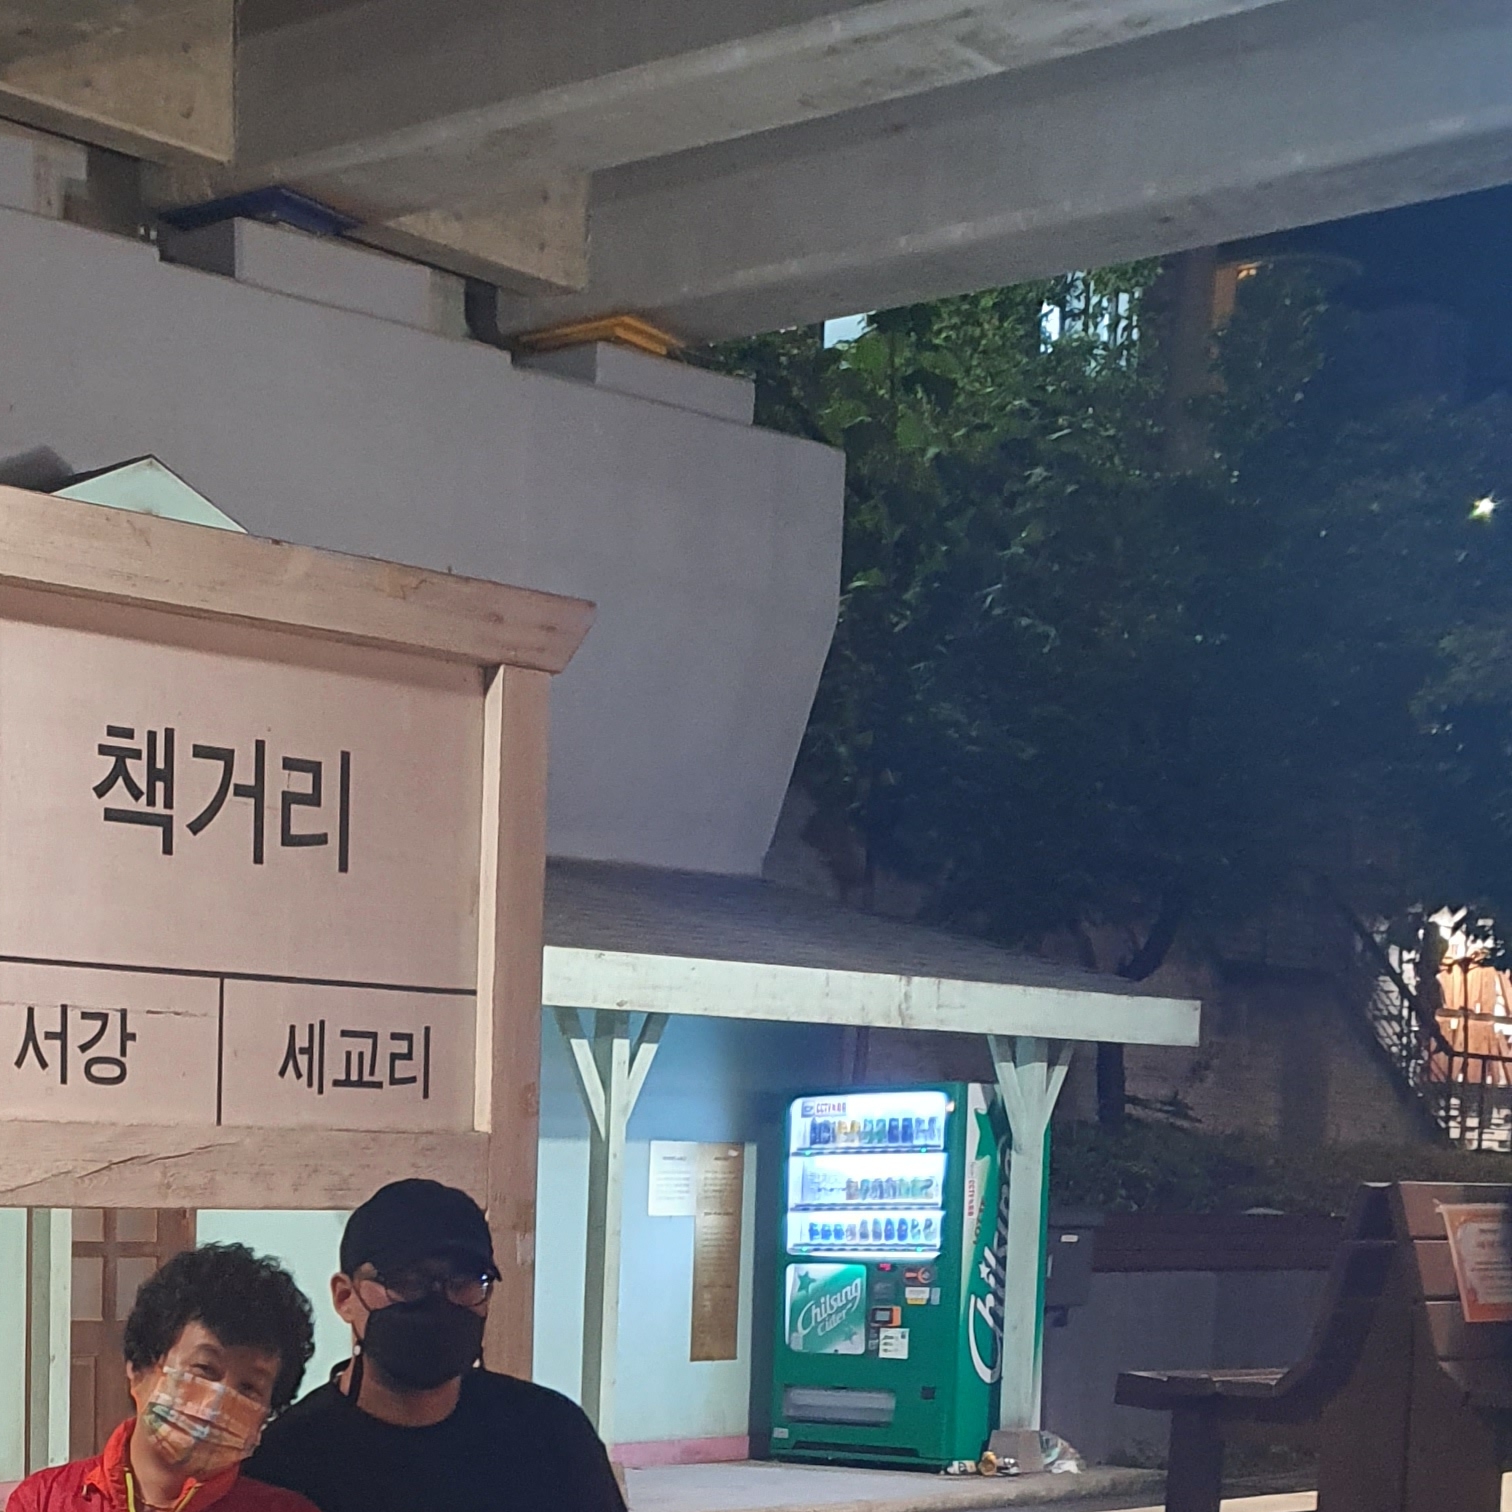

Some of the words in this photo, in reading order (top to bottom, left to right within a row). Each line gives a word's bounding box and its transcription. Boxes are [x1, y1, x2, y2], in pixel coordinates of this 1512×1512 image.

[92, 724, 351, 873] 책거리
[14, 1003, 137, 1085] 서강
[278, 1019, 431, 1100] 세교리
